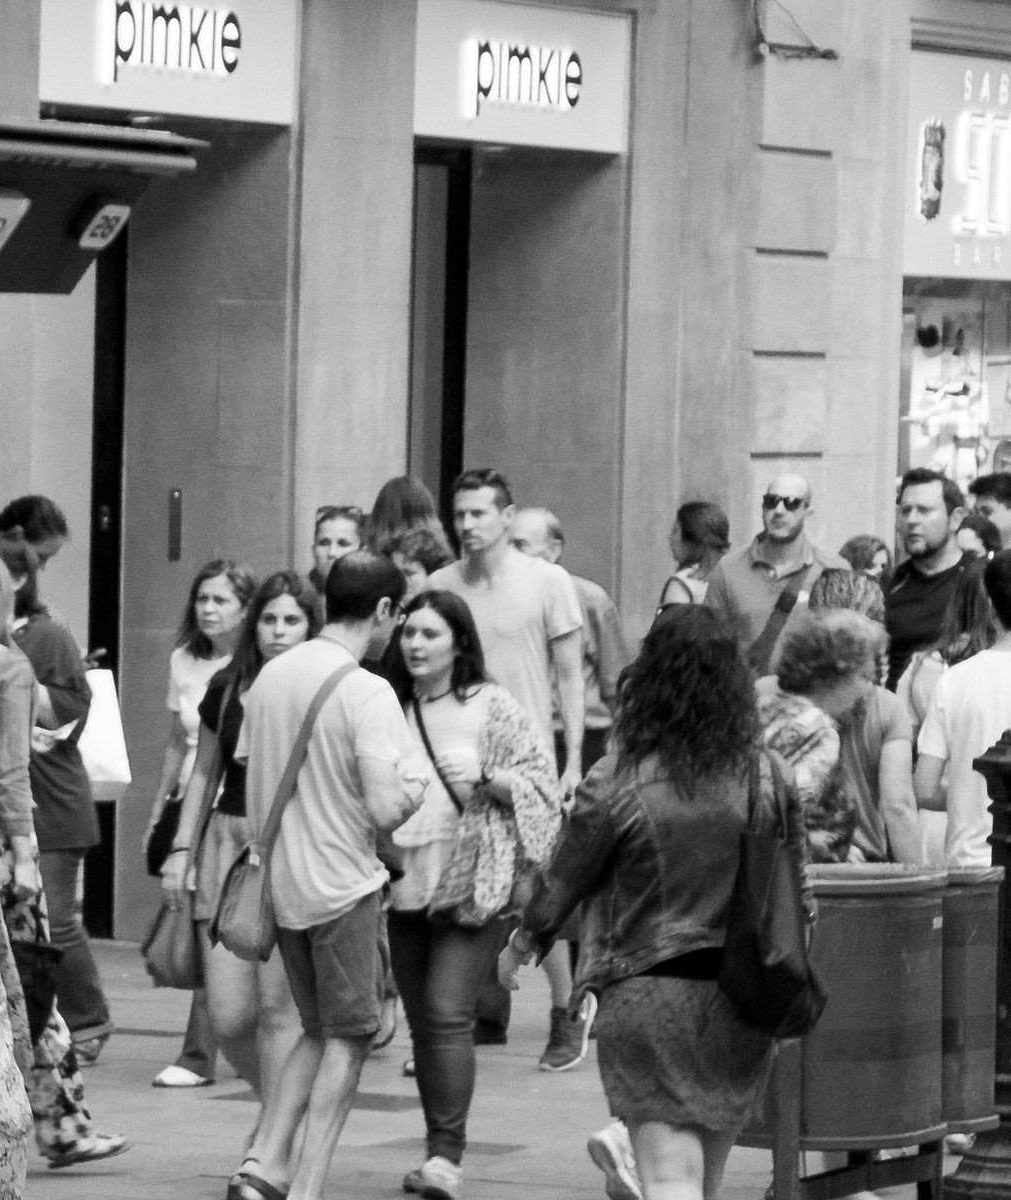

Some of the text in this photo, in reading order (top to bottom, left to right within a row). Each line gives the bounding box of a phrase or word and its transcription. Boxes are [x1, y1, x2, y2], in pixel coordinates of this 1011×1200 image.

[114, 1, 241, 82] pimkie
[476, 41, 582, 116] pimkie
[90, 215, 121, 238] 28
